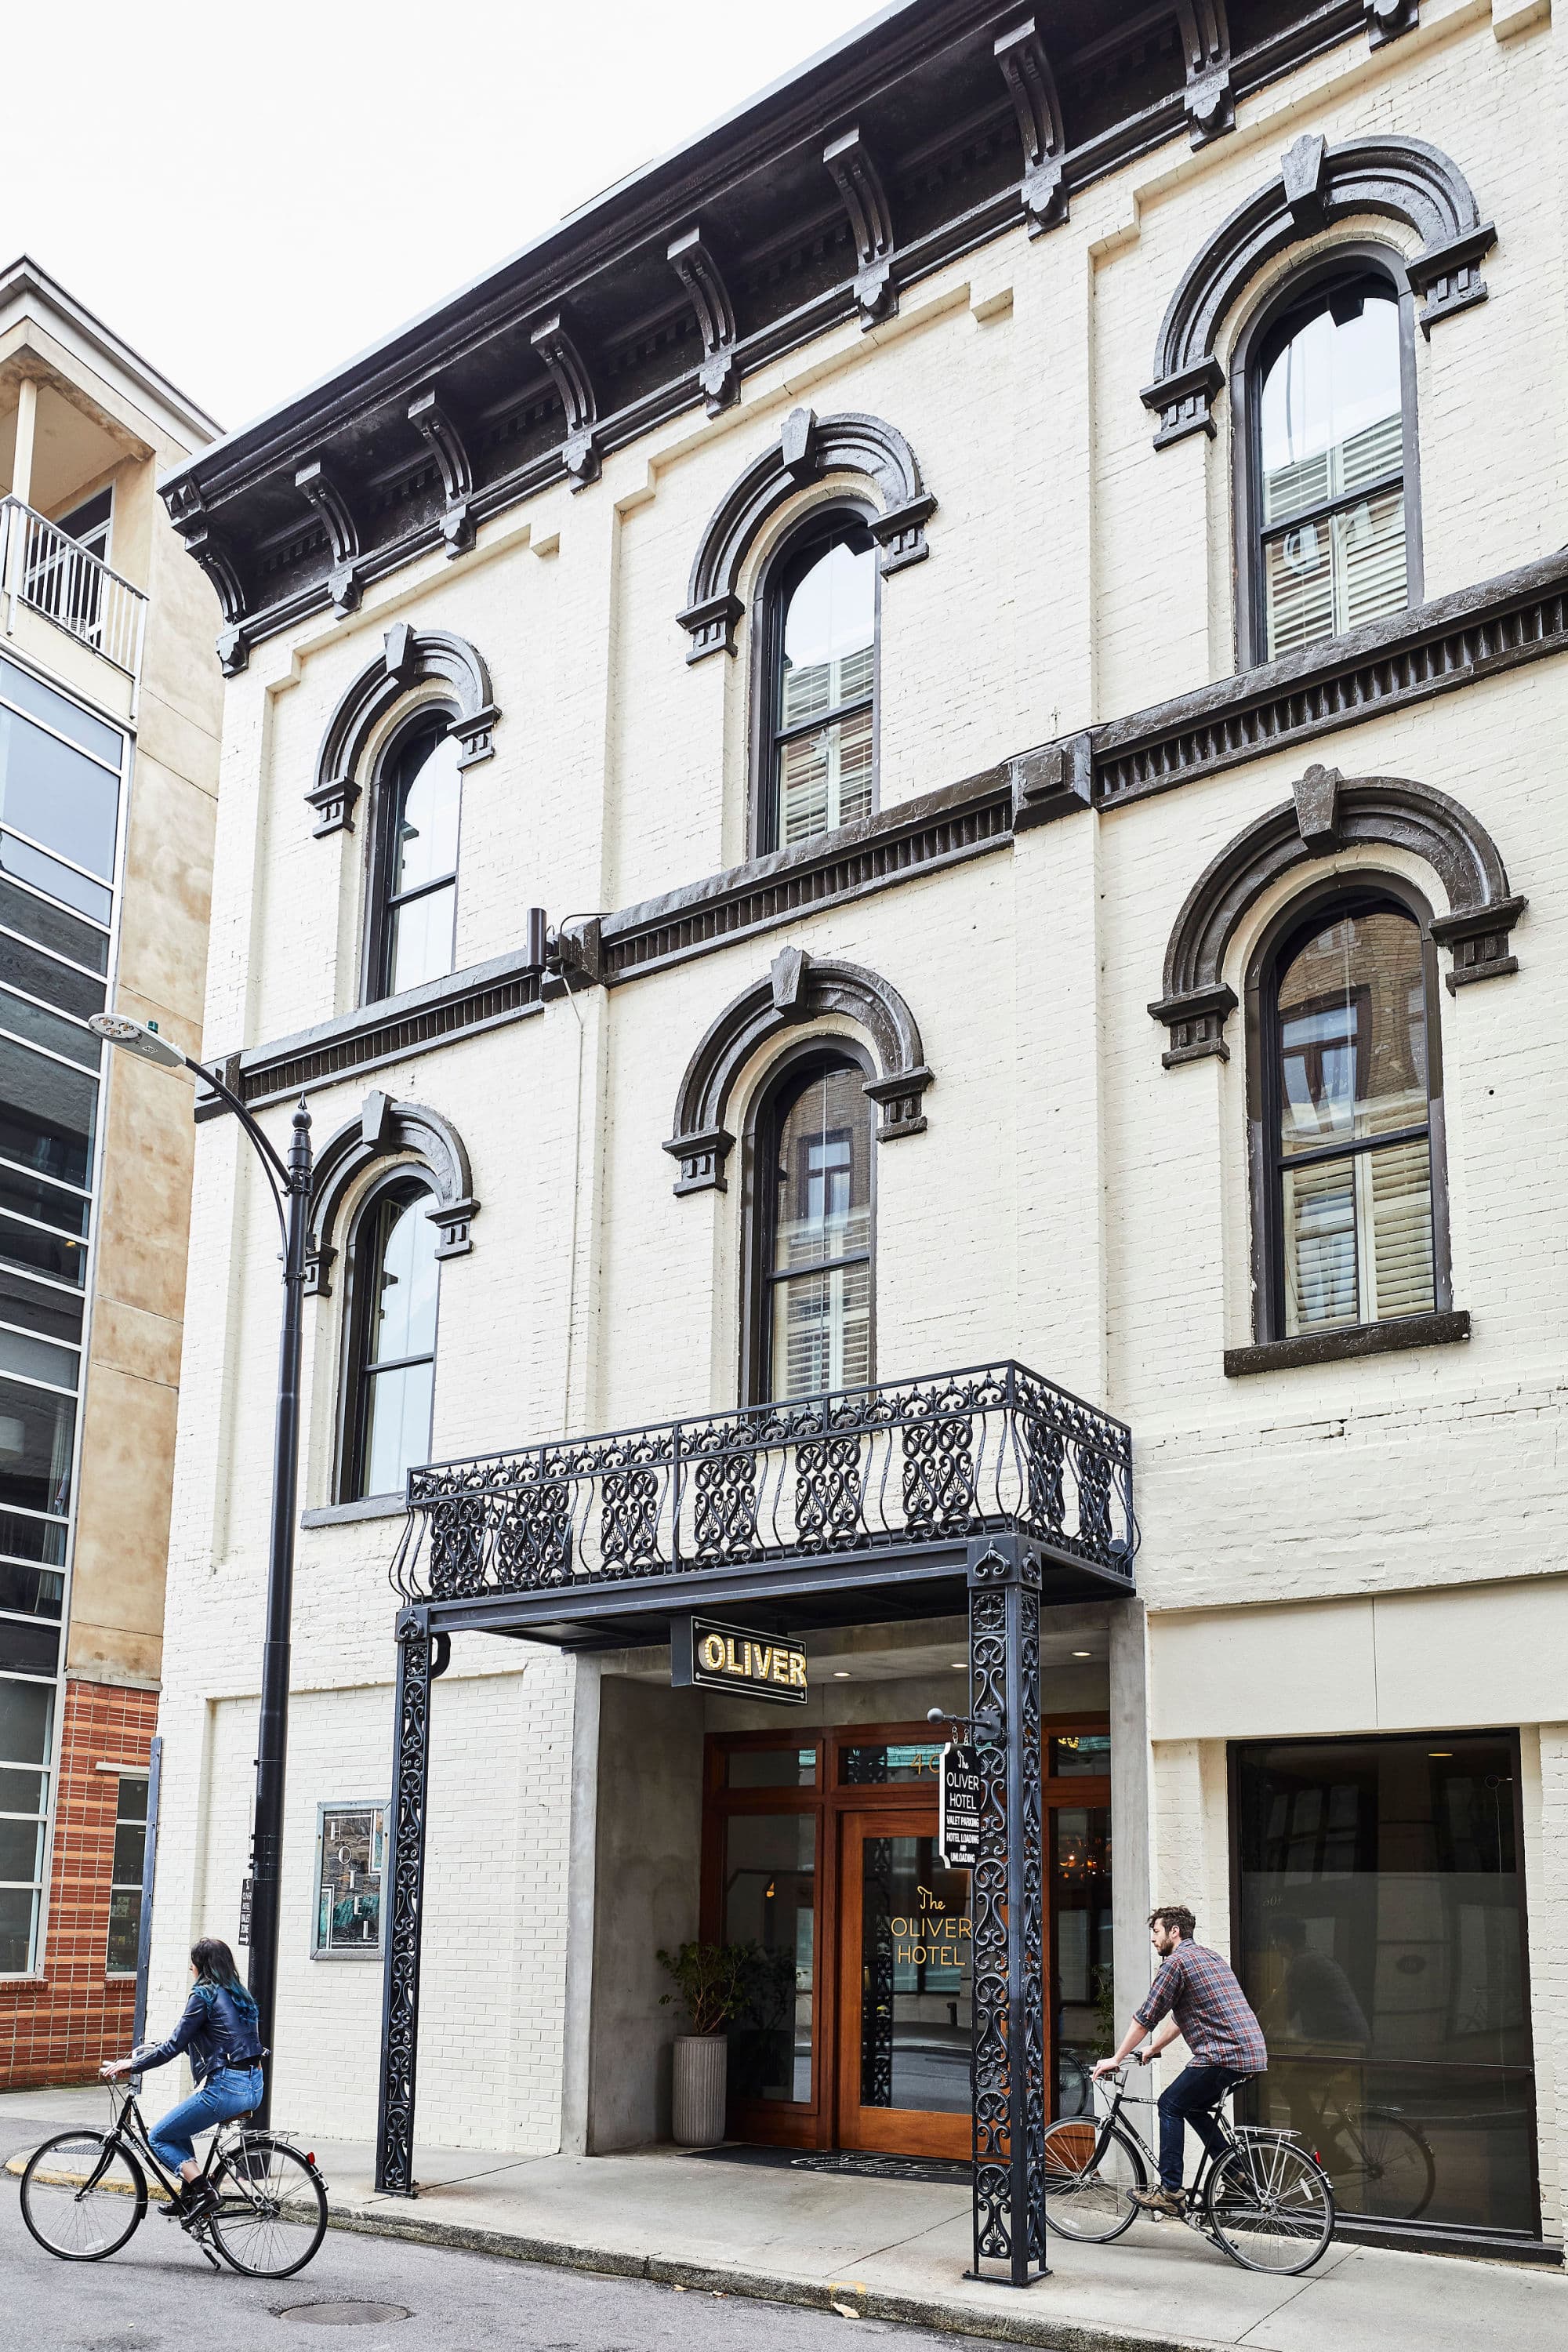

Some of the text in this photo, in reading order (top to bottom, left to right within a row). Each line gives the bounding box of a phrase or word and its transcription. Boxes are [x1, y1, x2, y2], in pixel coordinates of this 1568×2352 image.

[699, 1634, 808, 1687] OLIVER
[957, 1750, 969, 1769] The
[946, 1772, 979, 1791] OLIVER
[949, 1792, 977, 1809] HOTEL
[946, 1814, 980, 1828] VALET PARKING
[946, 1832, 980, 1844] HOTEL LOADING
[950, 1852, 975, 1864] UNLOADING
[917, 1886, 946, 1909] The
[891, 1917, 972, 1938] OLIVER
[898, 1945, 966, 1965] HOTEL
